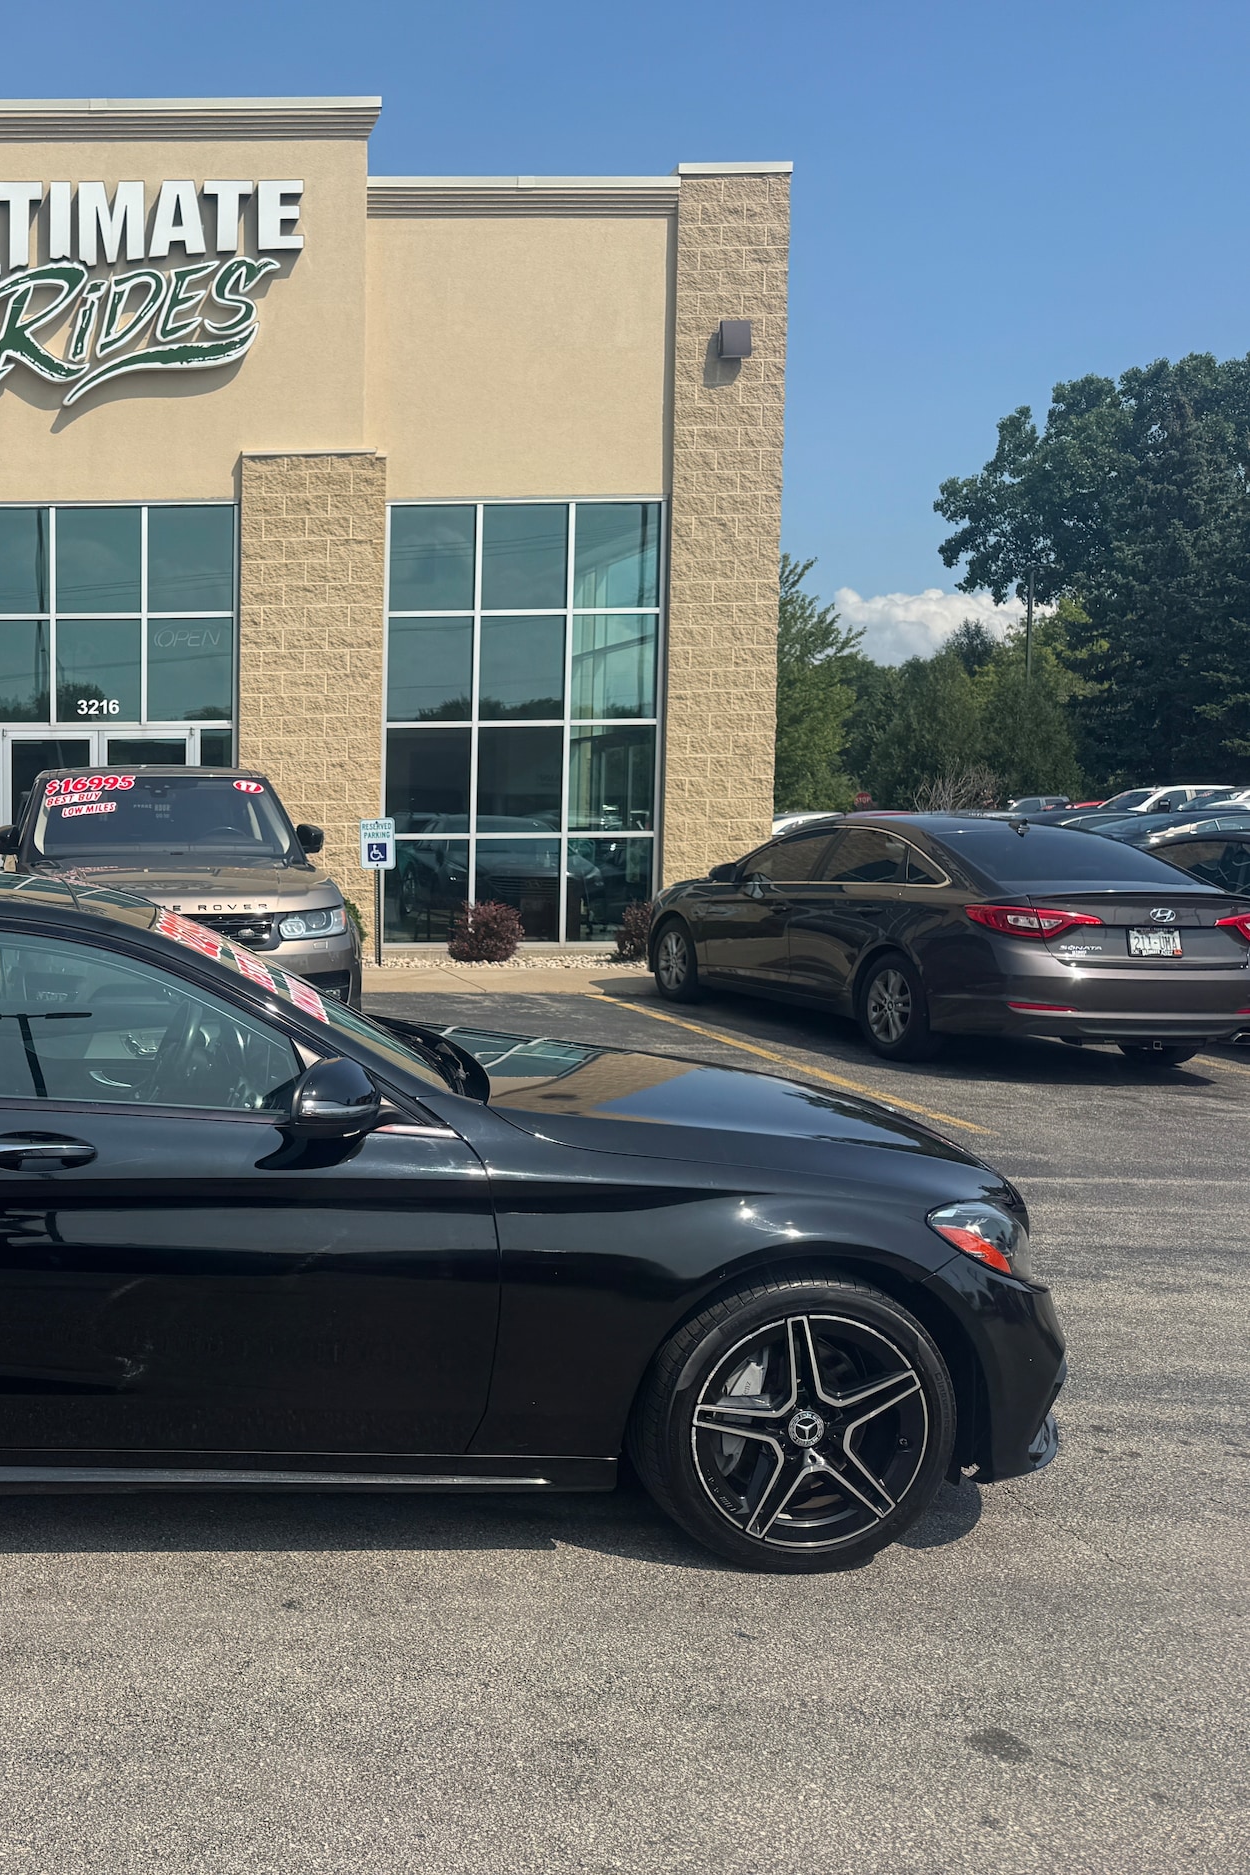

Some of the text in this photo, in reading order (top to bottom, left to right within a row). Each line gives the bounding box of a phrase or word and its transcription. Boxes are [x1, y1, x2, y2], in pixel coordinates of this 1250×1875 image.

[158, 629, 220, 647] OPEN
[76, 699, 120, 715] 3216
[45, 775, 136, 795] $16995
[239, 781, 258, 792] 17
[46, 792, 101, 807] BEST BUY
[63, 803, 116, 817] LOW MILES
[362, 822, 392, 831] RESERVED
[363, 831, 391, 839] PARKING
